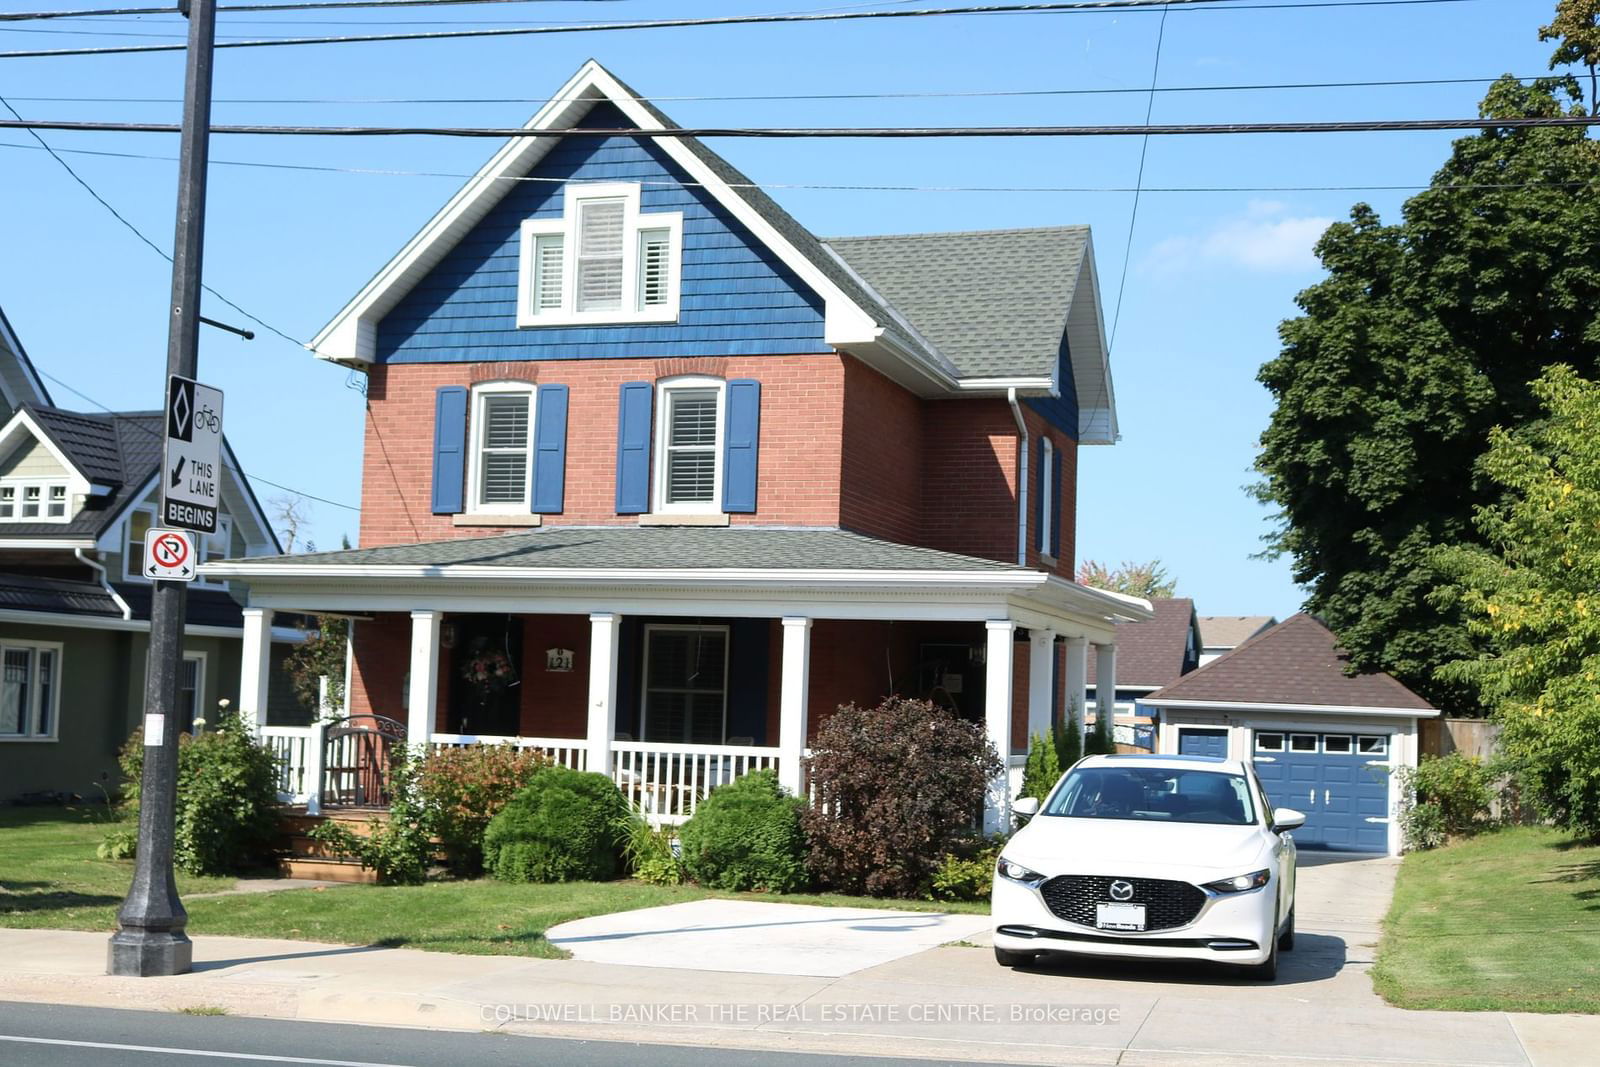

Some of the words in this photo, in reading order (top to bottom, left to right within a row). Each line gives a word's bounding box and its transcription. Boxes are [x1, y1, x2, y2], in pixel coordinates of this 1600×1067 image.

[191, 460, 213, 479] THIS
[189, 479, 214, 498] LANE
[168, 503, 213, 528] BEGINS
